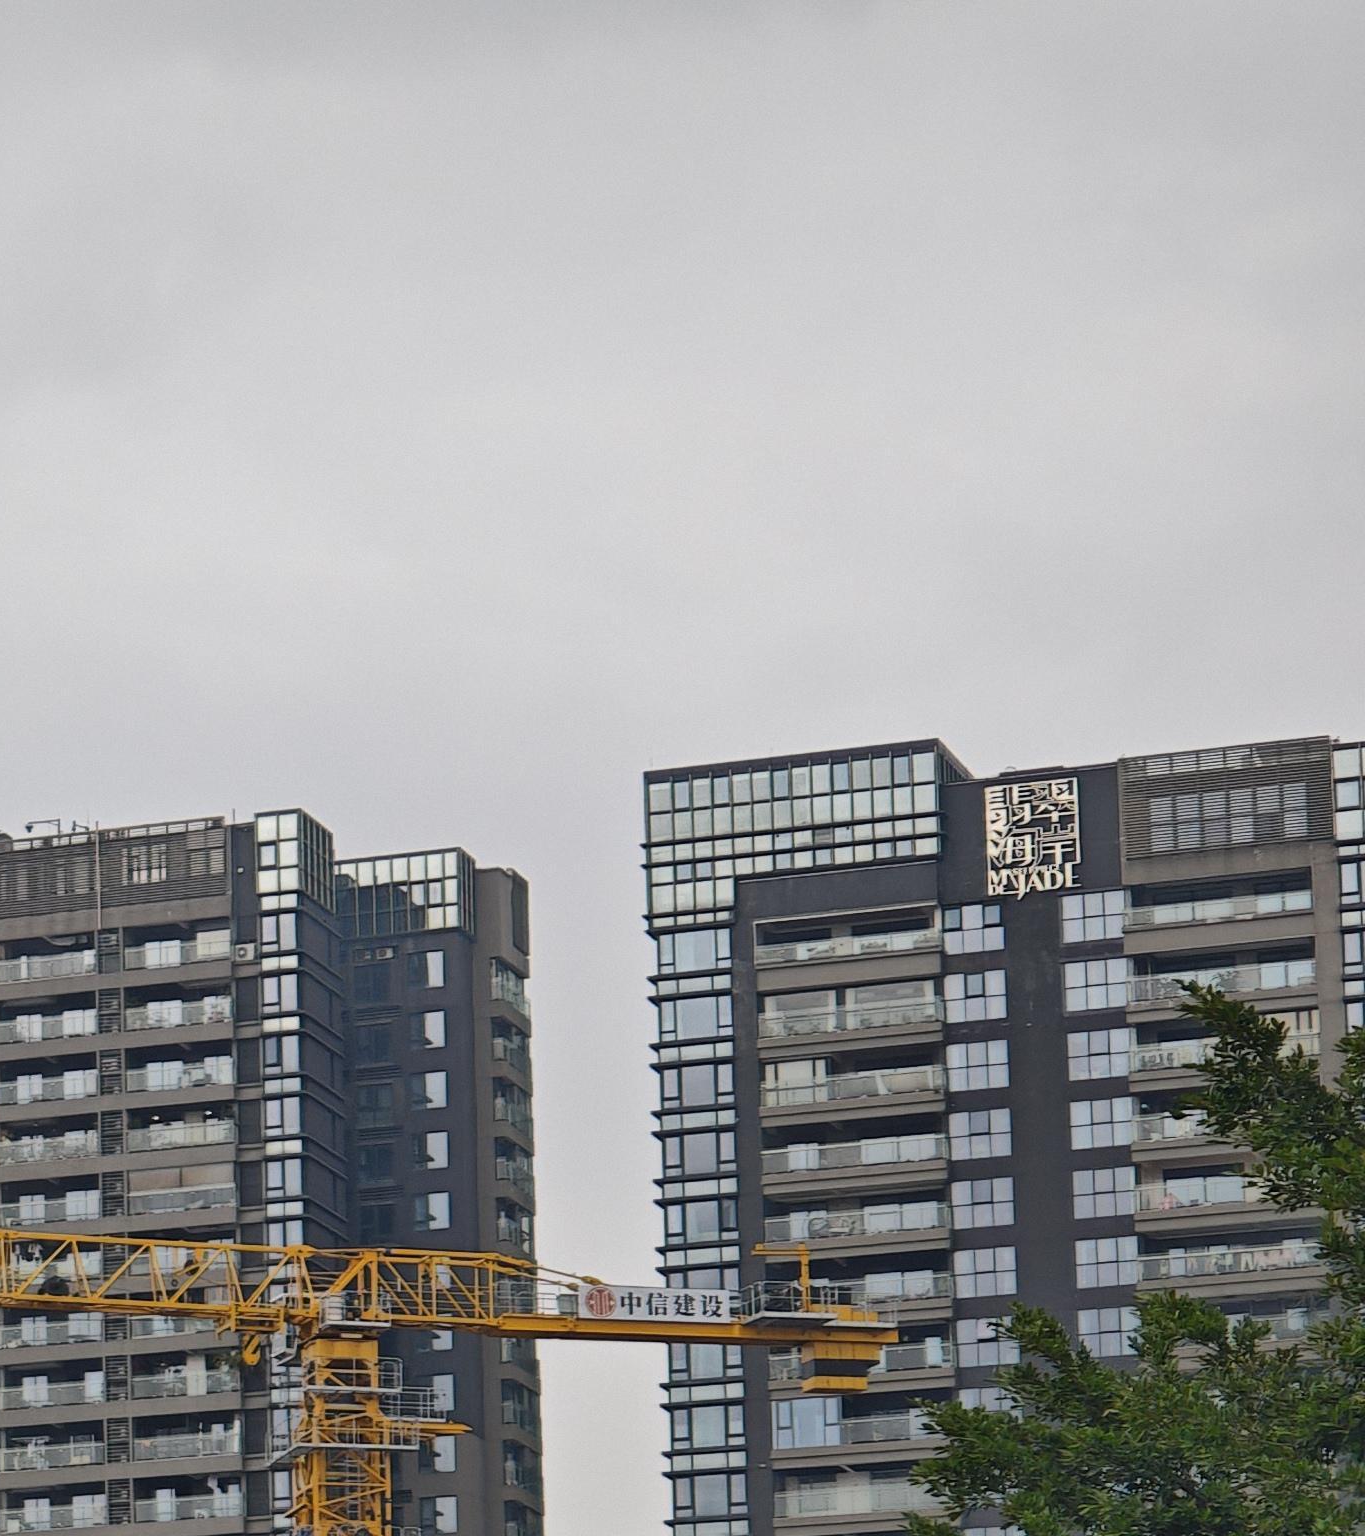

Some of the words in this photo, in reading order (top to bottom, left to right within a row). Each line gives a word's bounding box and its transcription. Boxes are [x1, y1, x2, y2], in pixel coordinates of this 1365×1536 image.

[984, 777, 1078, 827] 翡翠
[986, 822, 1081, 868] 海岸
[1017, 862, 1082, 900] JADE
[620, 1290, 724, 1318] 中信建设
